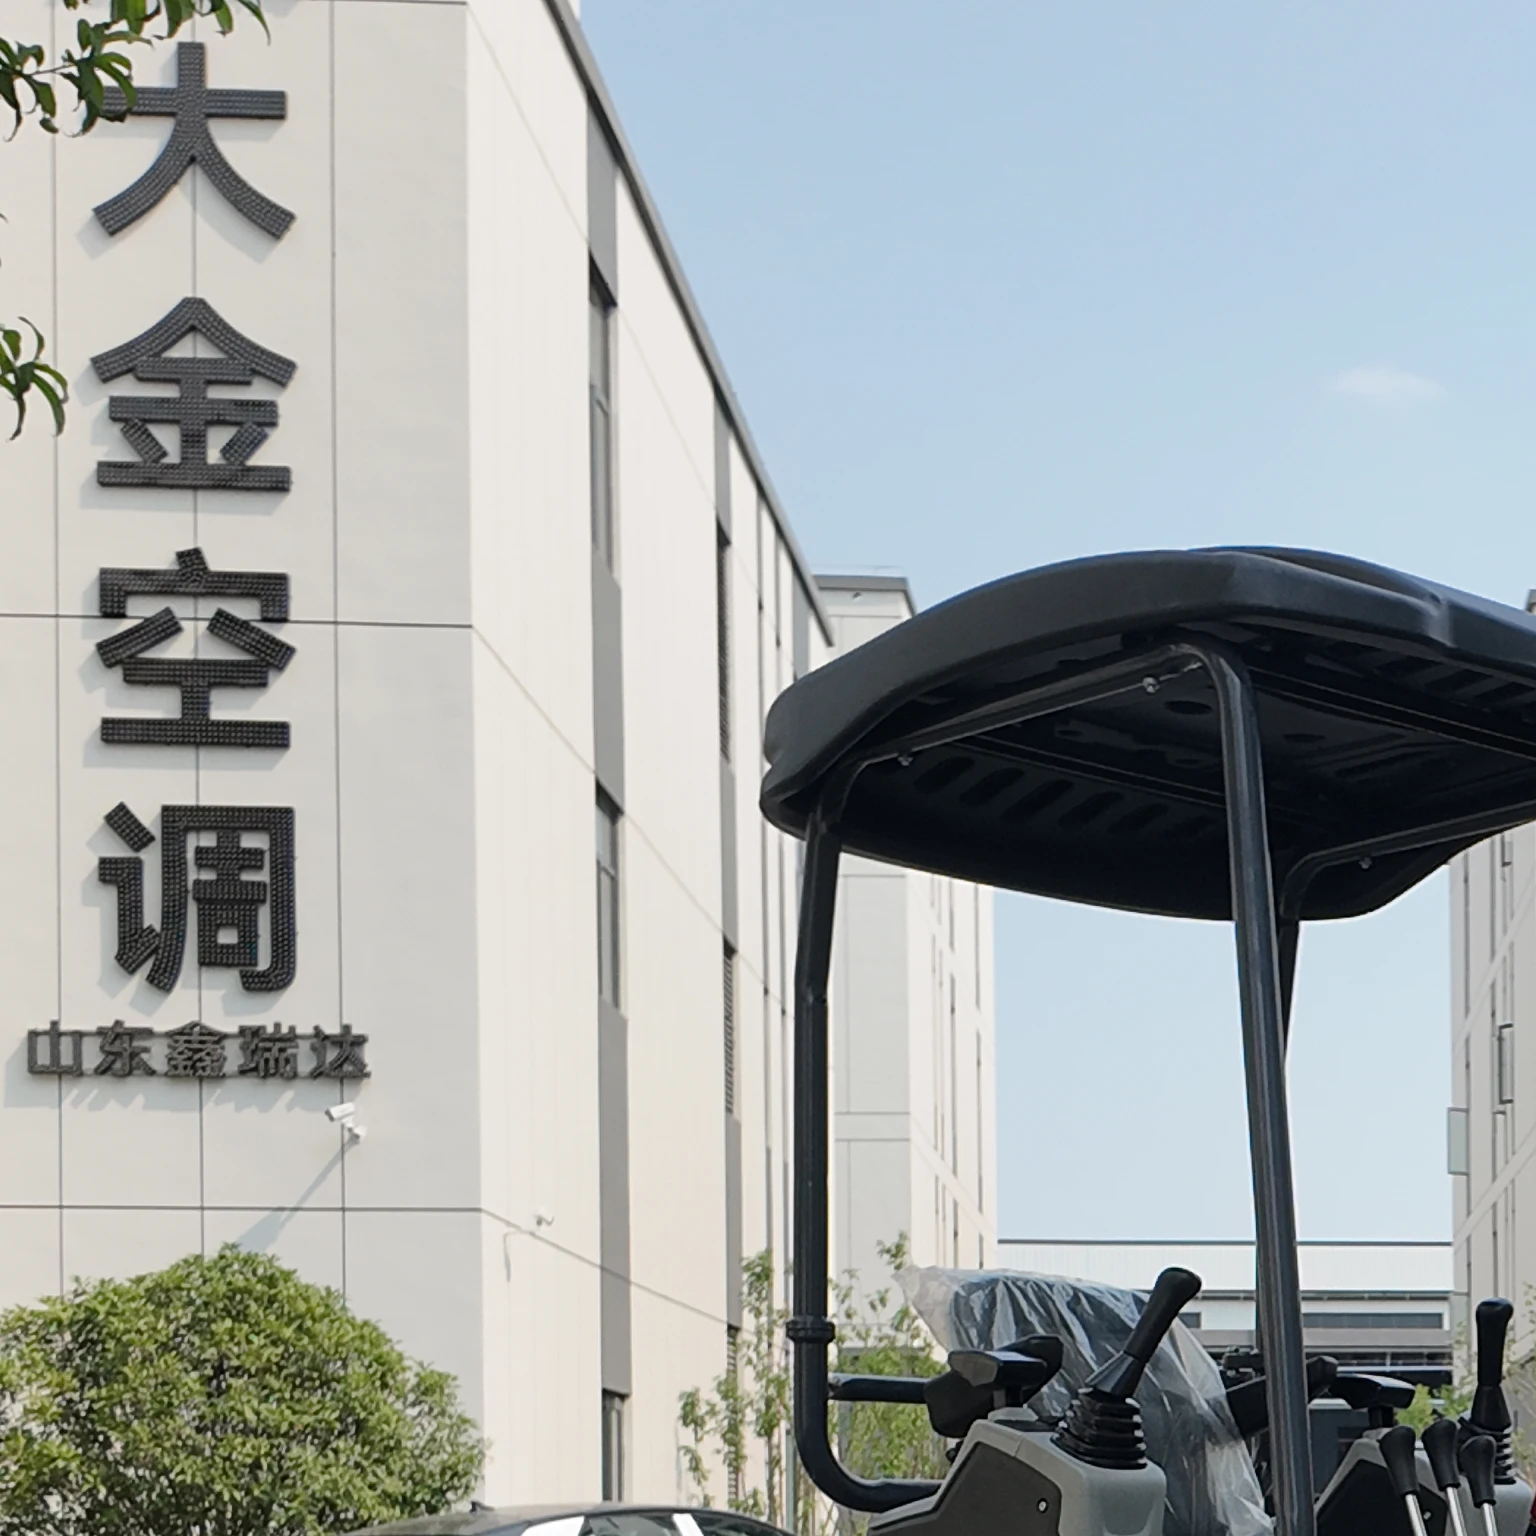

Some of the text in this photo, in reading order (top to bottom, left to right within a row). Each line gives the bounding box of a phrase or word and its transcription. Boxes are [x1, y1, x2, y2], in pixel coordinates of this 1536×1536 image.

[91, 41, 297, 992] 大金空调
[27, 1019, 372, 1079] 山东鑫瑞达
